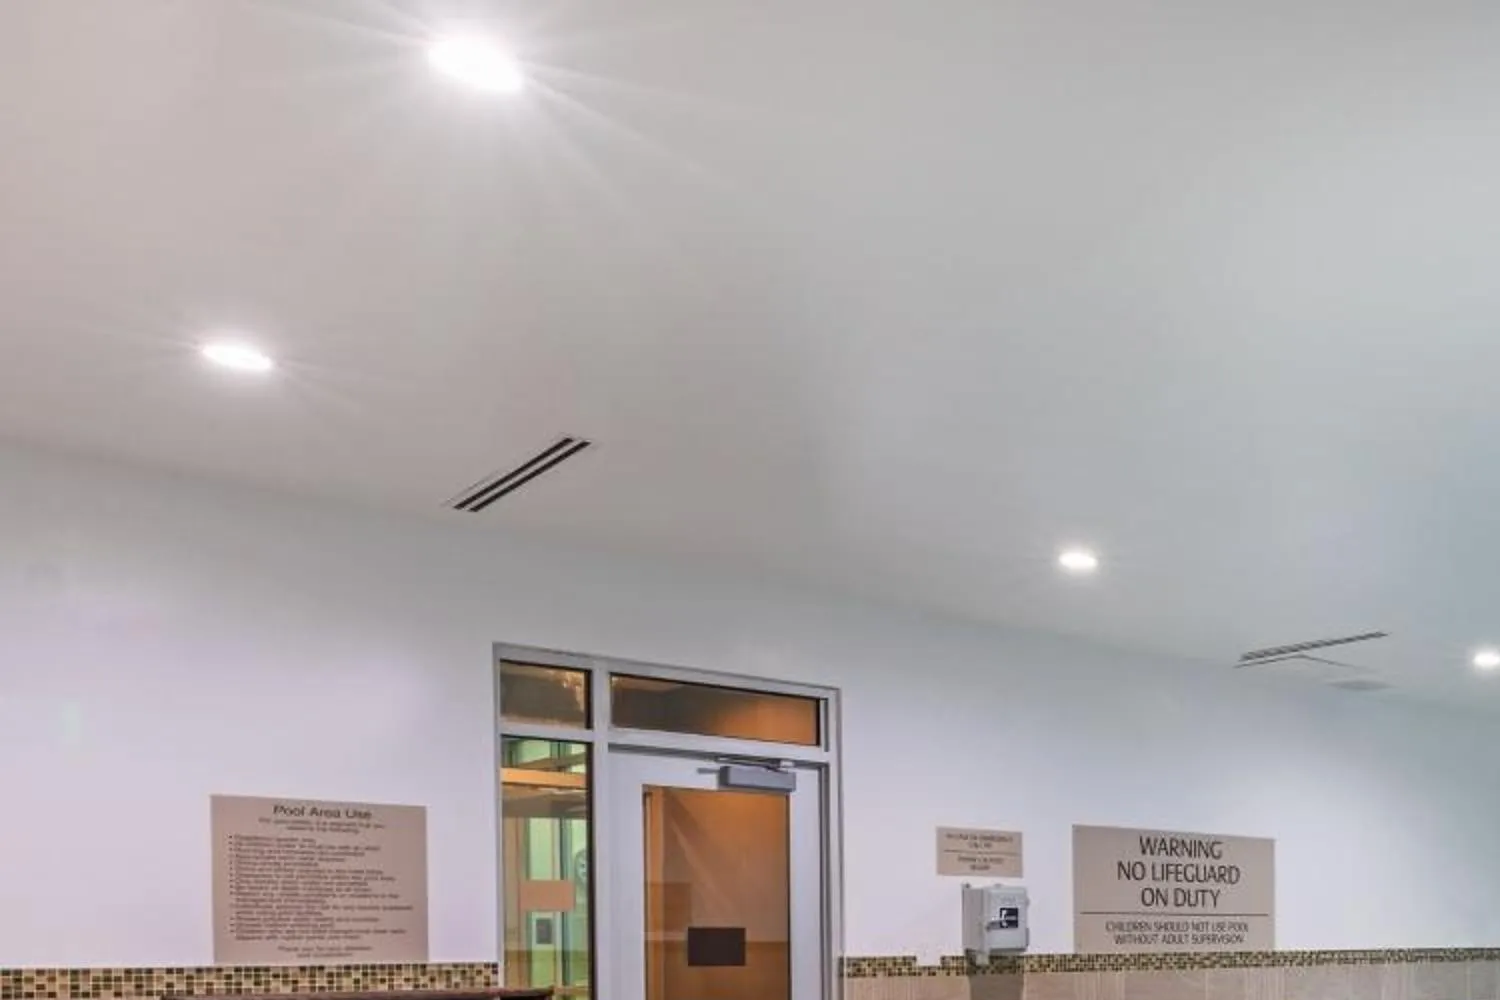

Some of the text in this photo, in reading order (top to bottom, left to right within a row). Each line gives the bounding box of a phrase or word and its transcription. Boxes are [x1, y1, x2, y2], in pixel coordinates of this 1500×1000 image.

[273, 805, 372, 819] Pool Area Use
[1139, 836, 1224, 860] WARNING
[1117, 861, 1240, 884] NO LIFEGUARD
[1141, 887, 1220, 908] ON DUTY
[1105, 921, 1151, 932] CHILDREN
[1153, 921, 1188, 932] SHOULD
[1192, 922, 1209, 932] NOT
[1212, 922, 1227, 932] USE
[1114, 933, 1244, 945] WITHOUT ADULT SUPERVISION
